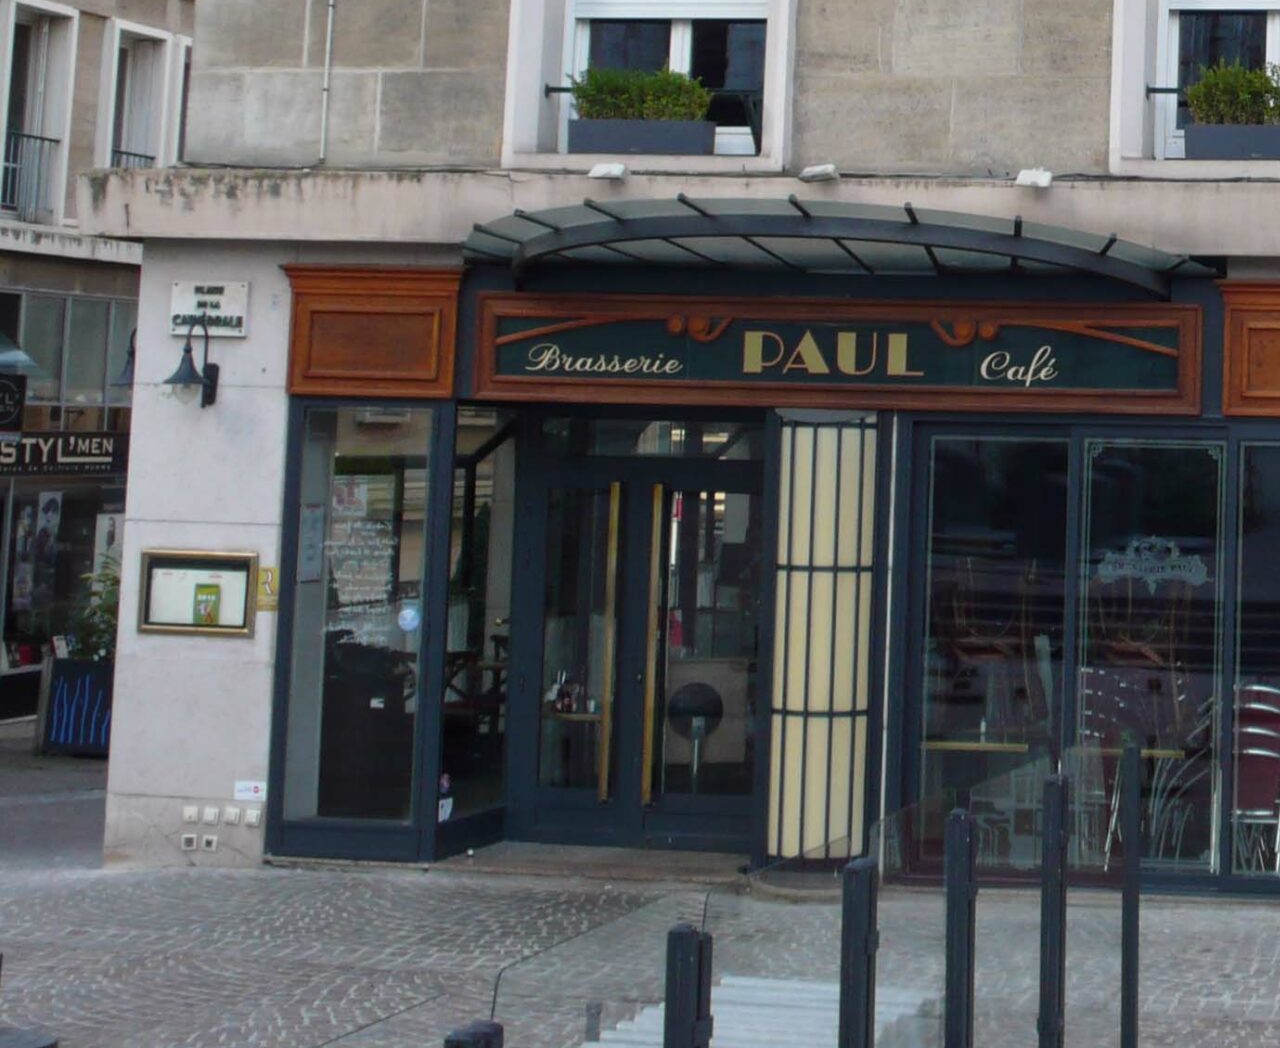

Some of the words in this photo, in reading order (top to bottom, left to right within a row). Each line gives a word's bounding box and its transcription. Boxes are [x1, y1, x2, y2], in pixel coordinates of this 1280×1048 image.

[525, 342, 684, 375] Brasserie
[742, 330, 925, 377] PAUL
[980, 345, 1060, 388] Café
